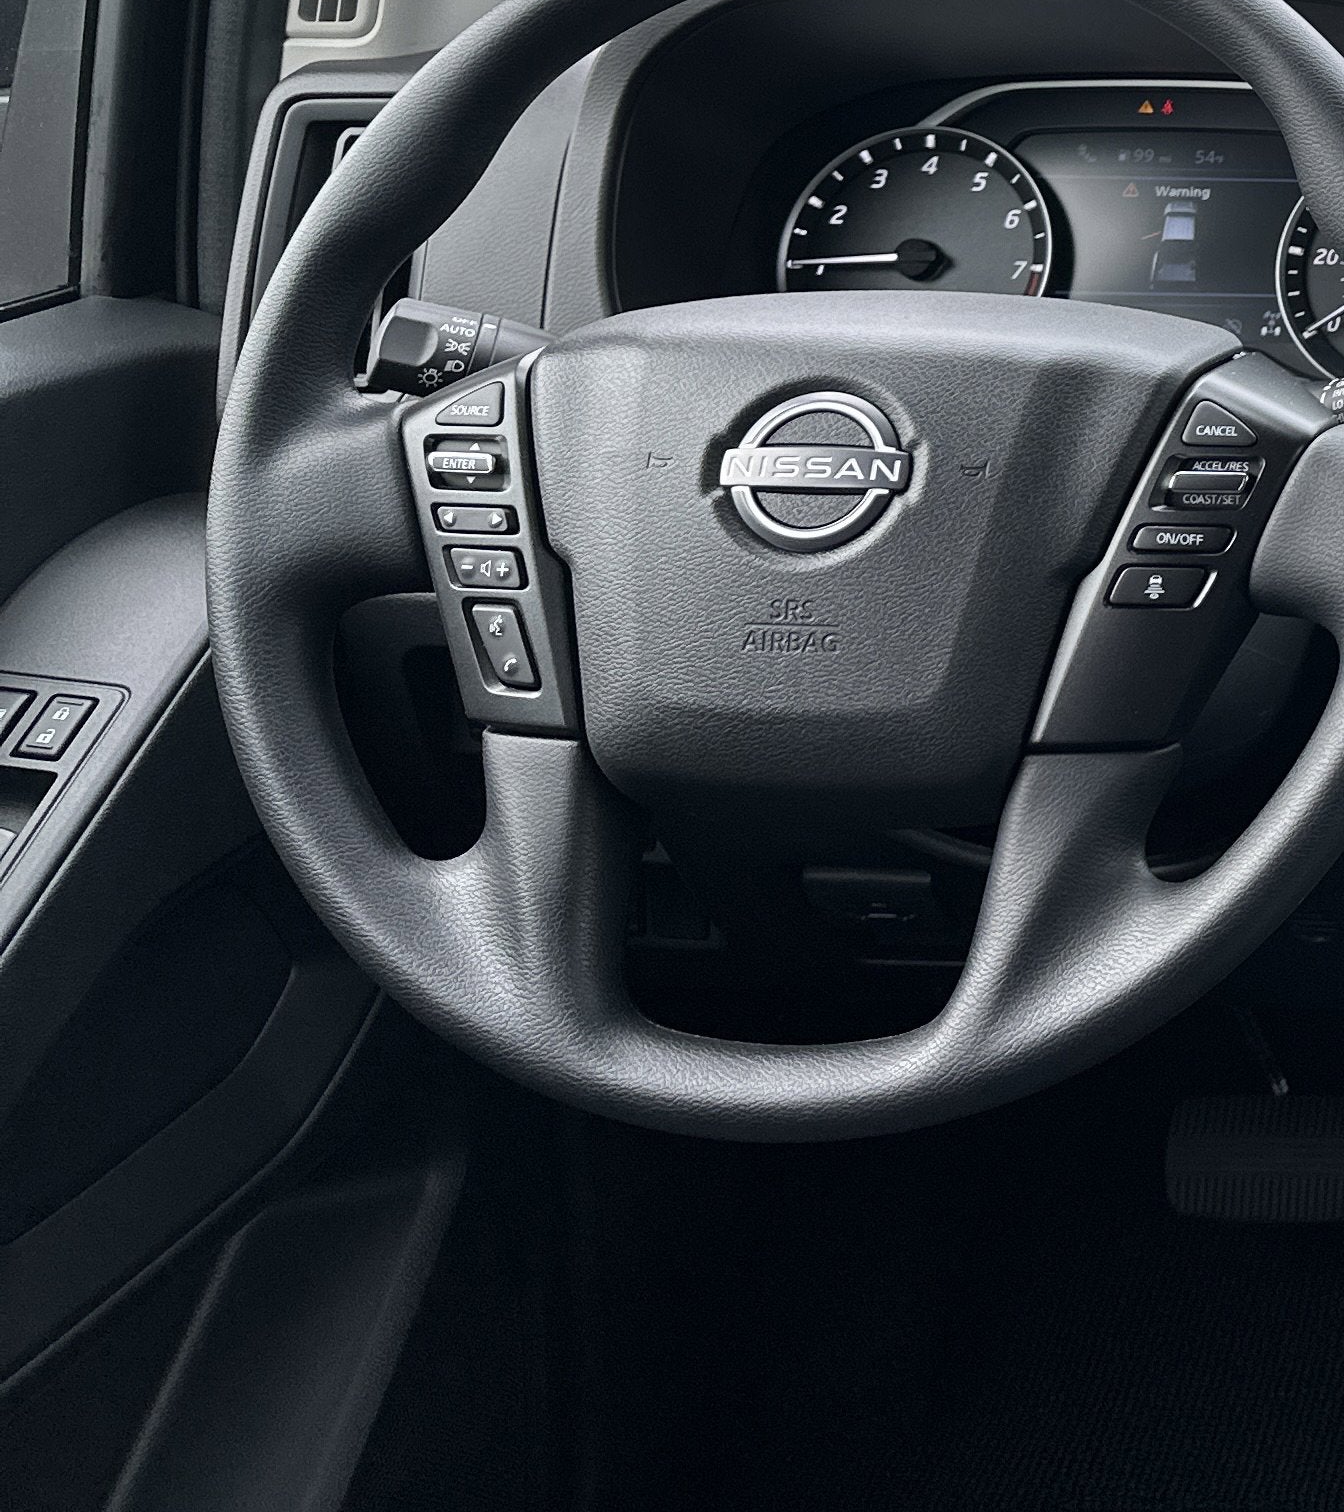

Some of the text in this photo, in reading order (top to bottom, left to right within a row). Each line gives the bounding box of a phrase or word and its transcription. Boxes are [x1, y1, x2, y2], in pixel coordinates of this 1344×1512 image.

[921, 155, 939, 175] 4
[869, 168, 888, 189] 3
[970, 171, 989, 192] 5
[1155, 185, 1211, 201] Warning
[828, 204, 848, 225] 2
[1003, 209, 1022, 229] 6
[1312, 248, 1340, 266] 20
[1011, 260, 1028, 280] 7
[440, 323, 476, 338] AUTO
[450, 405, 490, 417] SOURCE
[1331, 398, 1344, 410] LO
[1195, 425, 1238, 437] CANCEL
[442, 458, 476, 470] ENTER
[727, 455, 902, 482] NISSAN
[1192, 460, 1250, 472] ACCEL/RES
[1182, 493, 1241, 505] COAST/SET
[1155, 532, 1205, 546] ON/OFF
[769, 599, 814, 619] SRS
[741, 631, 838, 653] AIRBAG
